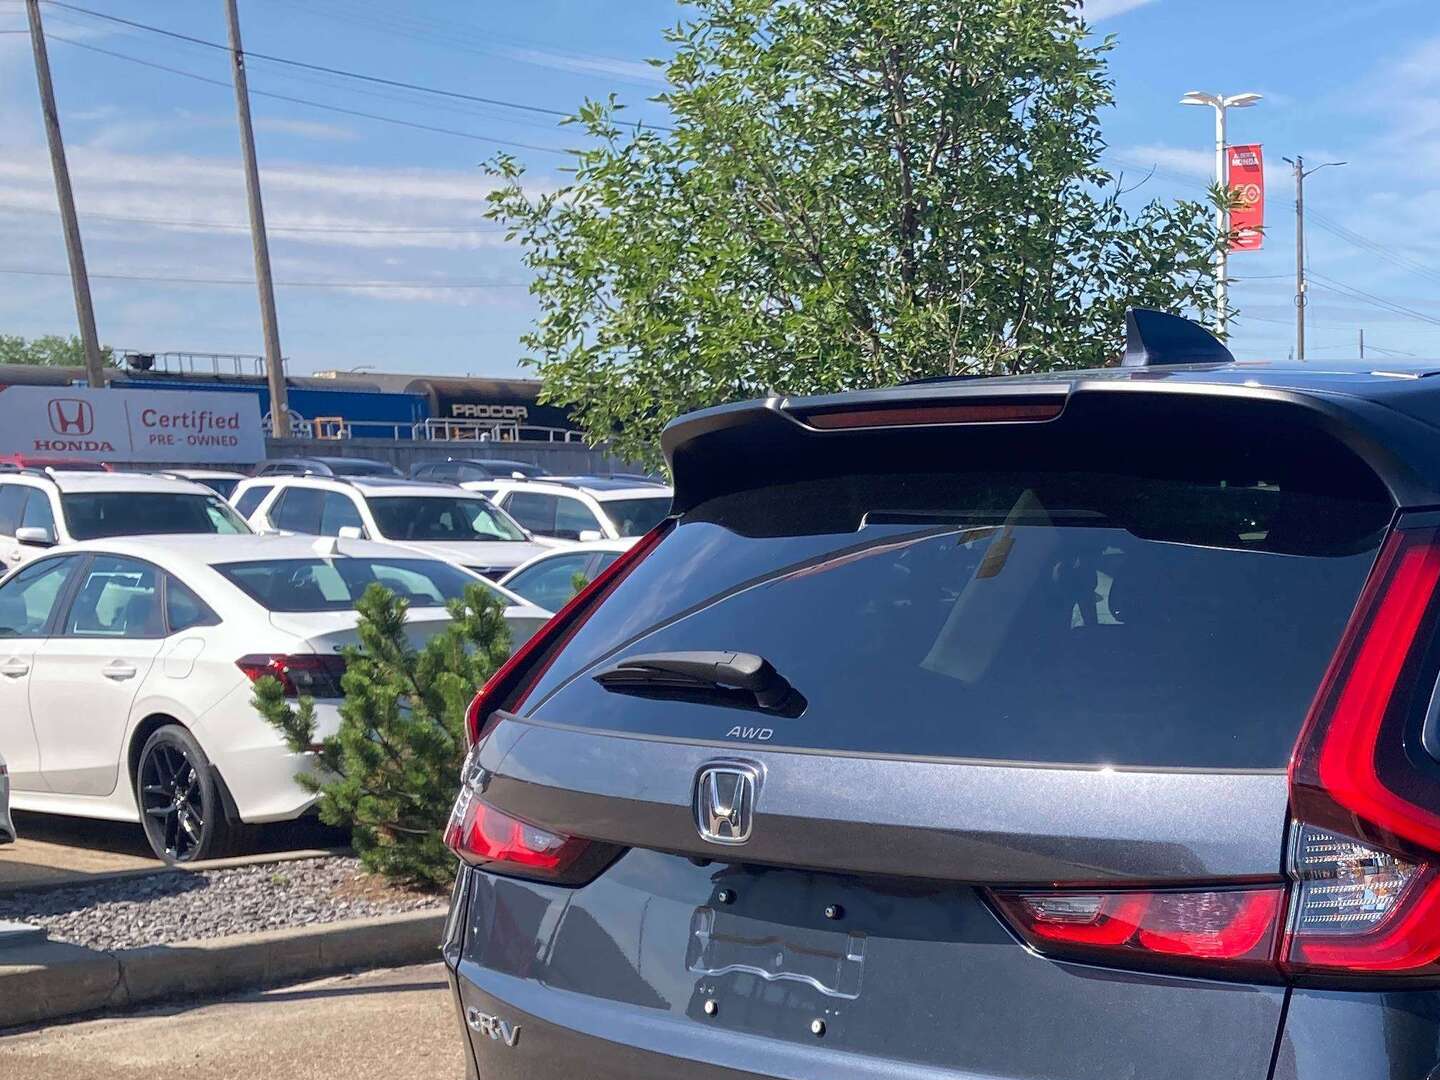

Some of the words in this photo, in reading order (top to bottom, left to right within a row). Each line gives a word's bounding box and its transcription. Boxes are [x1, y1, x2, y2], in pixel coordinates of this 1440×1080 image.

[452, 403, 529, 419] PROCOR
[142, 408, 241, 433] Certified
[34, 440, 114, 451] HONDA
[726, 726, 773, 740] AWD
